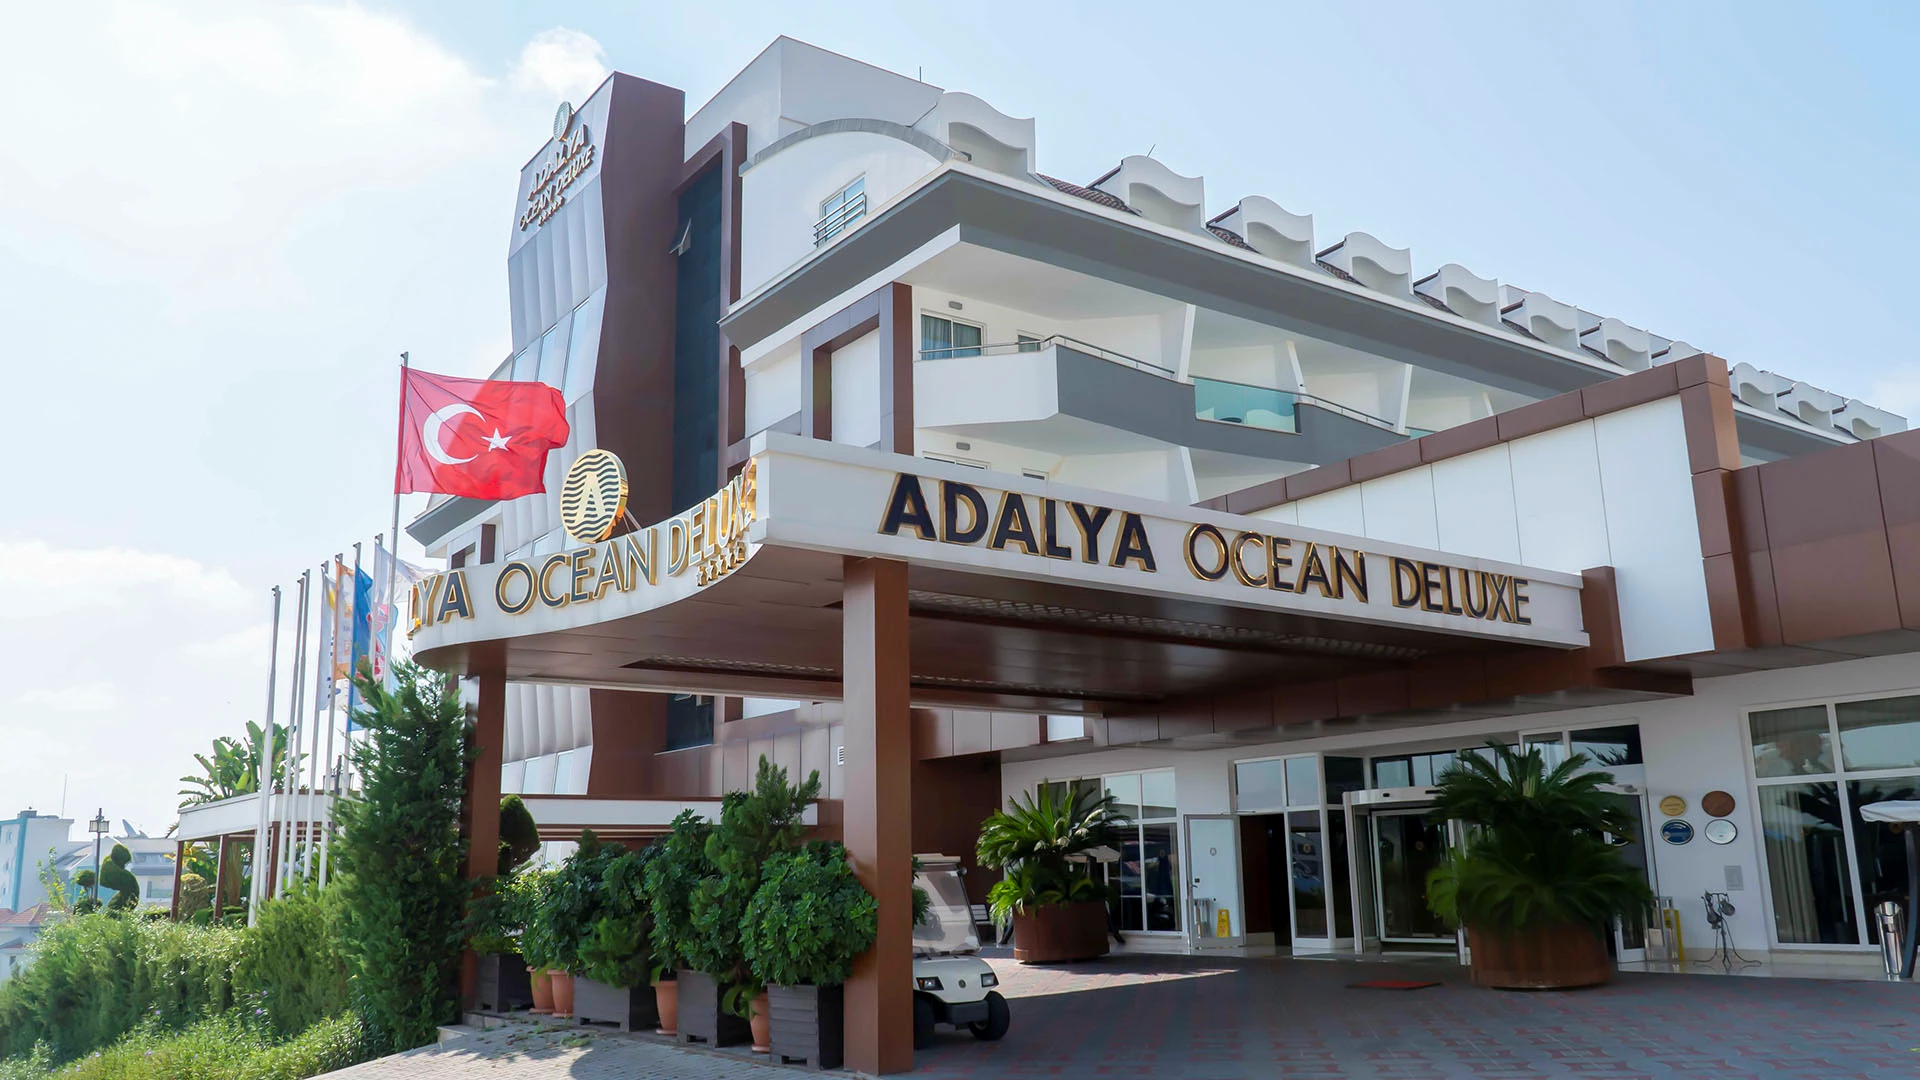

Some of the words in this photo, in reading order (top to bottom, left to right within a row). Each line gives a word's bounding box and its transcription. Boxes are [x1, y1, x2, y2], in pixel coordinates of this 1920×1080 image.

[519, 184, 557, 232] OCEAN
[556, 143, 596, 196] DELUXE
[528, 123, 588, 201] ADALYA
[495, 530, 657, 615] OCEAN
[667, 456, 757, 577] DELUXE
[877, 472, 1157, 573] ADALYA
[1183, 523, 1369, 604] OCEAN
[1392, 556, 1532, 625] DELUXE
